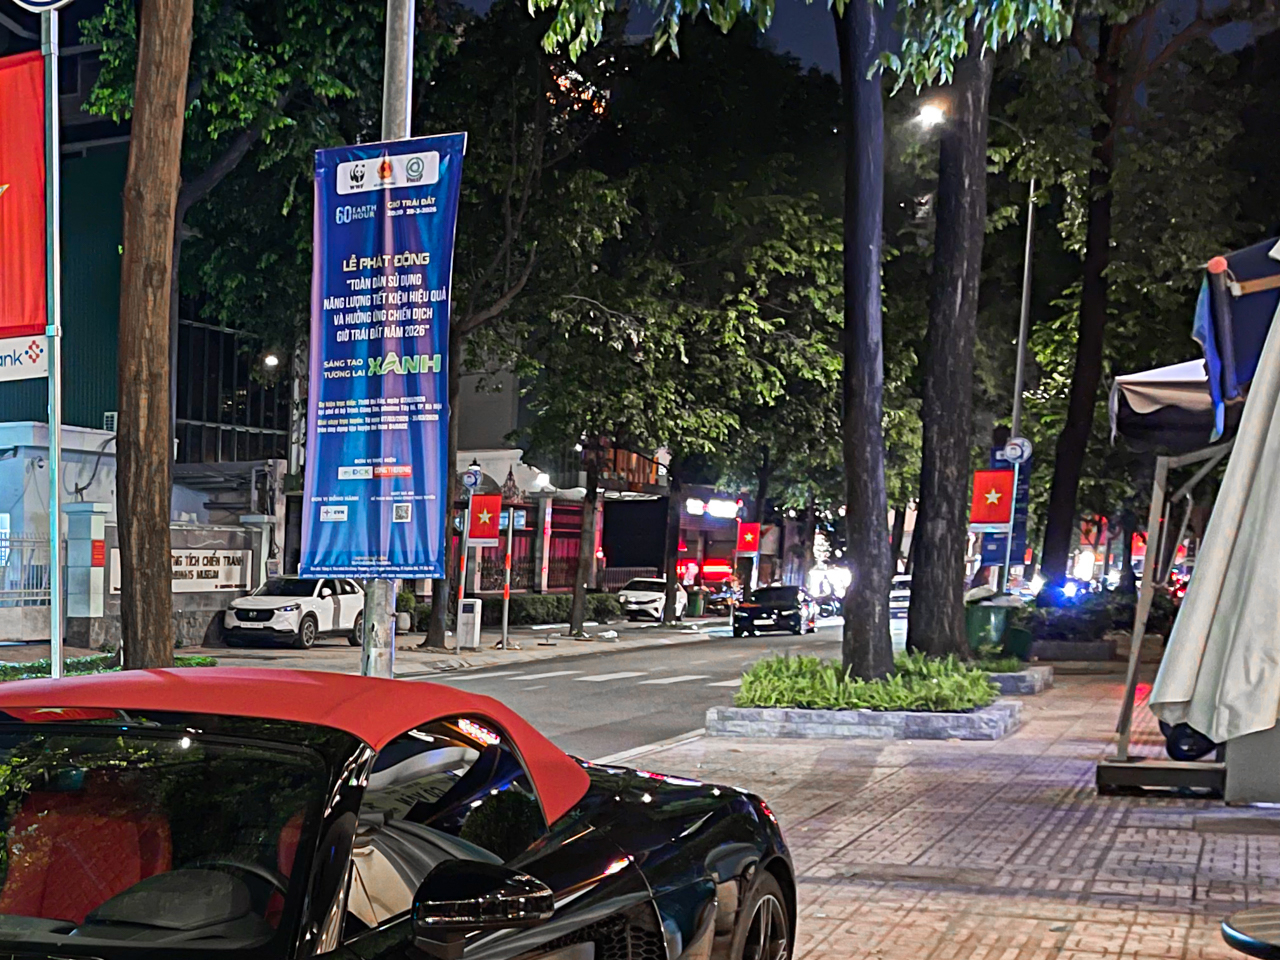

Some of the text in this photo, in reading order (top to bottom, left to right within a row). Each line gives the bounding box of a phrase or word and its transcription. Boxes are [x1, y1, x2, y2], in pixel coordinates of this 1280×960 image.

[353, 205, 377, 213] EARTH
[402, 197, 420, 207] TRÁI
[336, 205, 352, 225] 60
[353, 211, 375, 220] HOUR
[343, 251, 430, 272] LỄ PHÁT ĐỘNG
[324, 296, 345, 310] NĂNG
[410, 289, 429, 304] HIỆU
[334, 312, 344, 326] VÀ
[413, 307, 433, 321] DỊCH
[351, 326, 369, 341] TRÁI
[384, 325, 403, 338] NĂM
[324, 358, 364, 368] SÁNG TẠO
[368, 351, 441, 376] XANH
[352, 369, 365, 377] LAI
